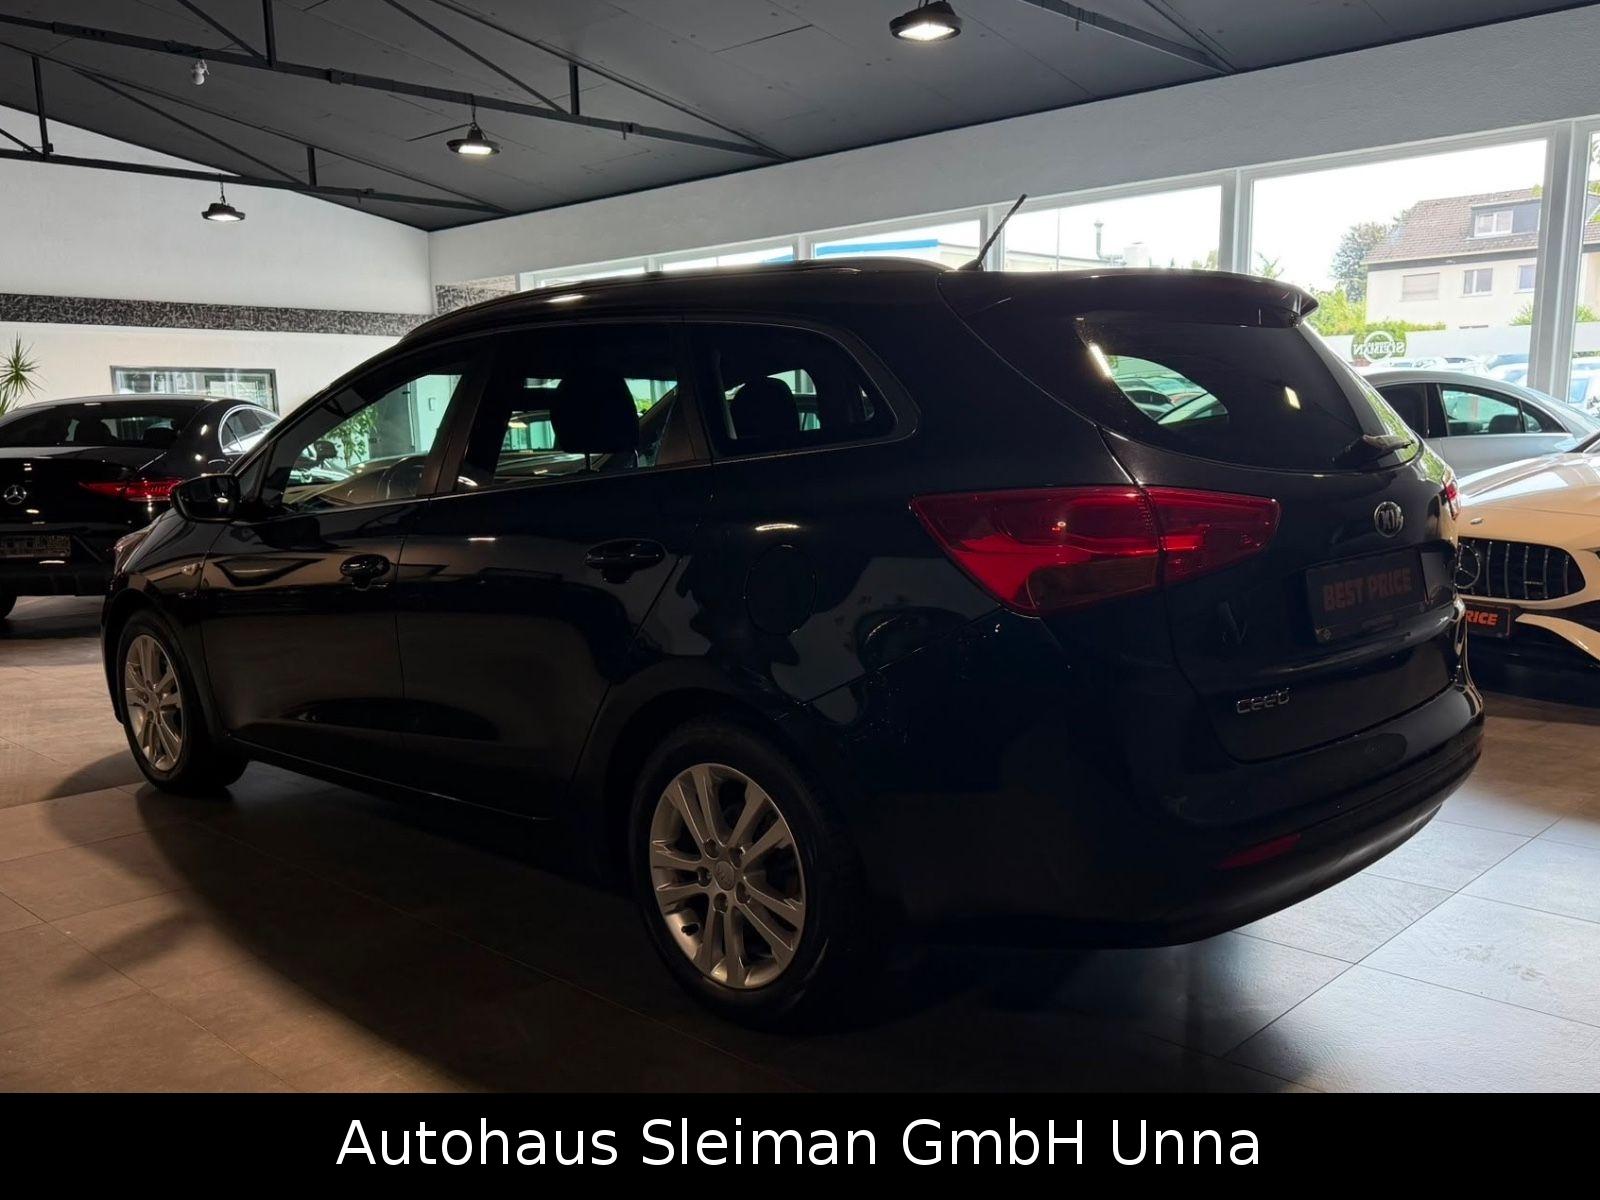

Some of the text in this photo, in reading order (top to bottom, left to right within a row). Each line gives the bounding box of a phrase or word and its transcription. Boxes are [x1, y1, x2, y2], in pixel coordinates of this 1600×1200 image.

[1323, 568, 1411, 611] BEST PRICE
[1464, 610, 1498, 626] RICE
